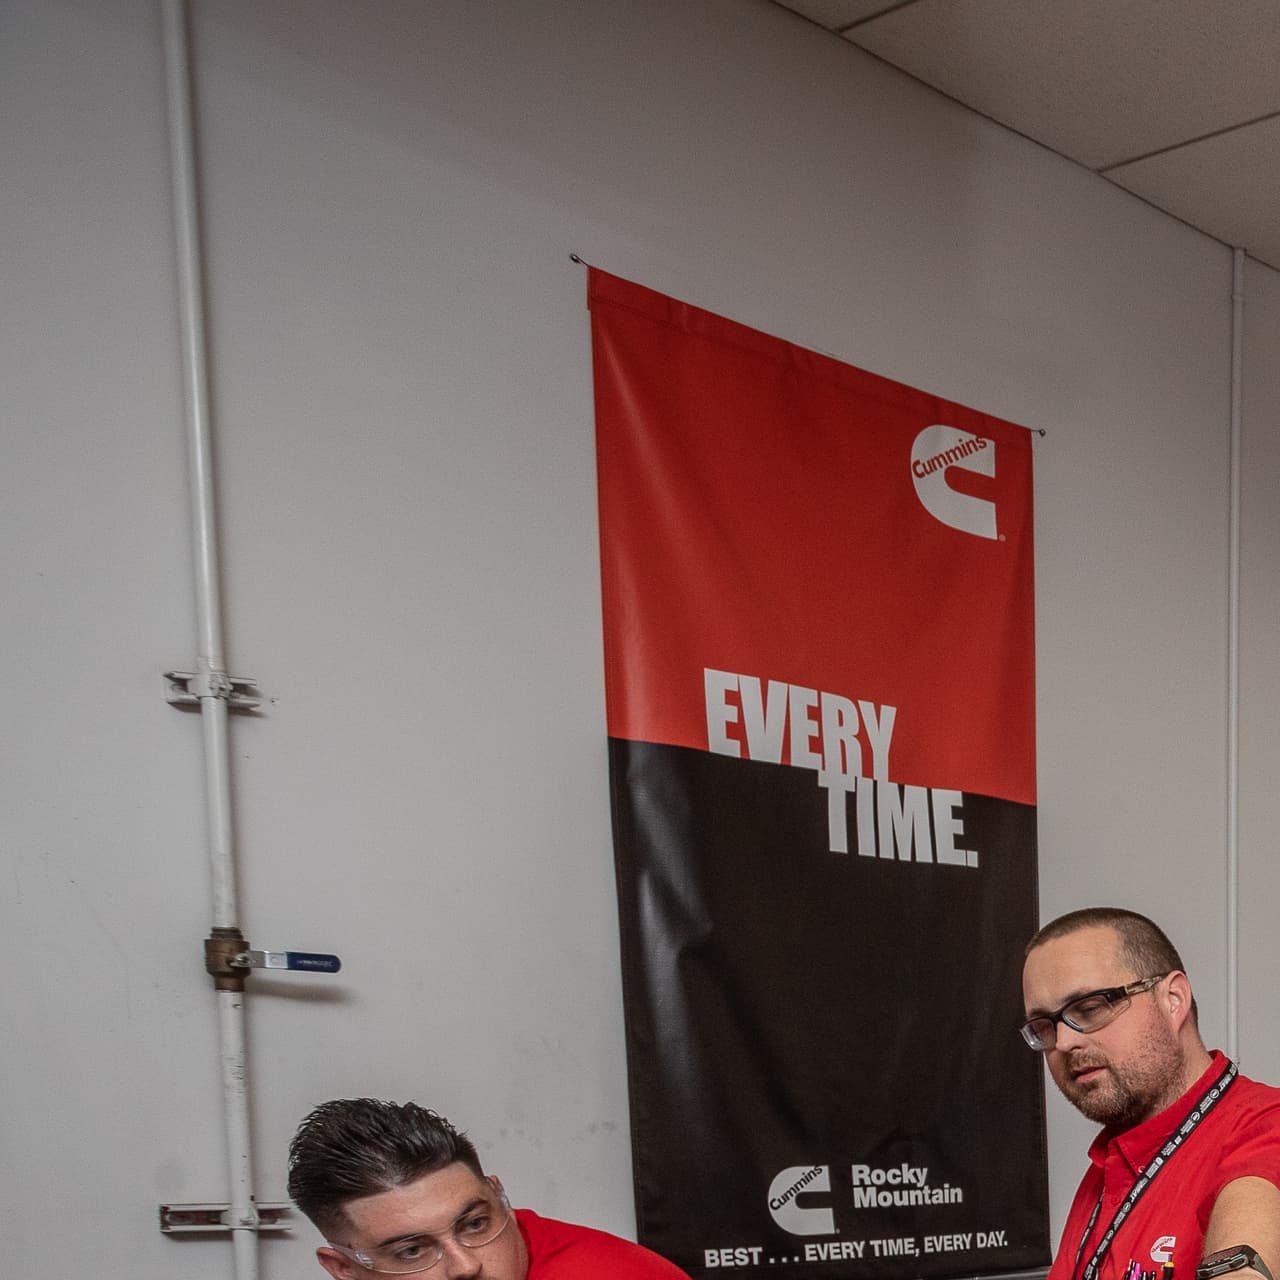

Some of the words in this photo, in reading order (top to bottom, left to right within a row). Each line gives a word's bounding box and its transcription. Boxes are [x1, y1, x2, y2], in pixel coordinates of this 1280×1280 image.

[911, 437, 988, 479] Cummins
[703, 667, 897, 784] EVERY
[817, 770, 979, 868] TIME.
[769, 1165, 823, 1211] Cummins
[852, 1163, 928, 1187] Rocky
[853, 1183, 963, 1209] Mountain
[704, 1247, 762, 1268] BEST
[805, 1242, 866, 1262] EVERY
[869, 1238, 920, 1257] TIME,
[923, 1233, 973, 1253] EVERY
[976, 1230, 1008, 1248] DAY.
